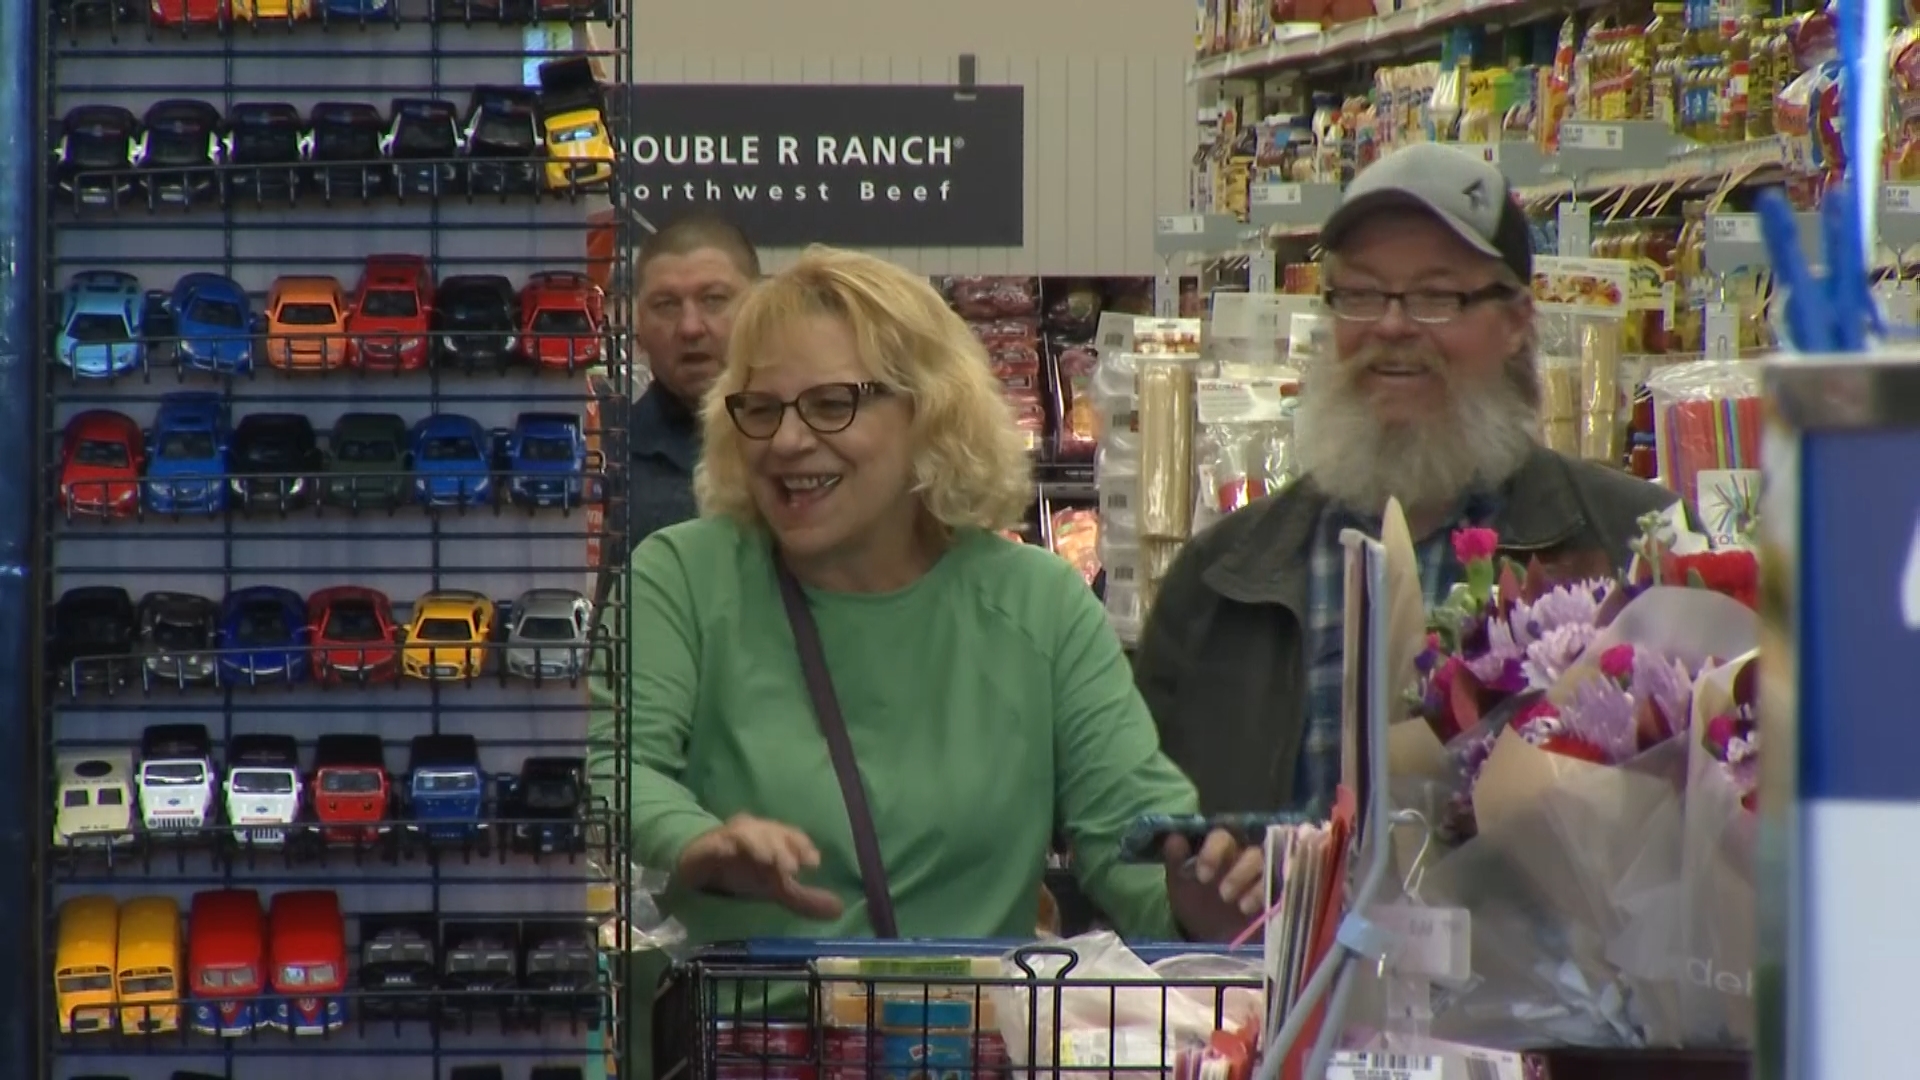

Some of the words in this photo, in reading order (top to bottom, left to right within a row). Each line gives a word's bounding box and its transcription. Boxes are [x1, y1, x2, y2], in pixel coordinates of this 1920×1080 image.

[778, 135, 799, 165] R
[618, 179, 829, 200] orthwest
[861, 180, 951, 201] Beef
